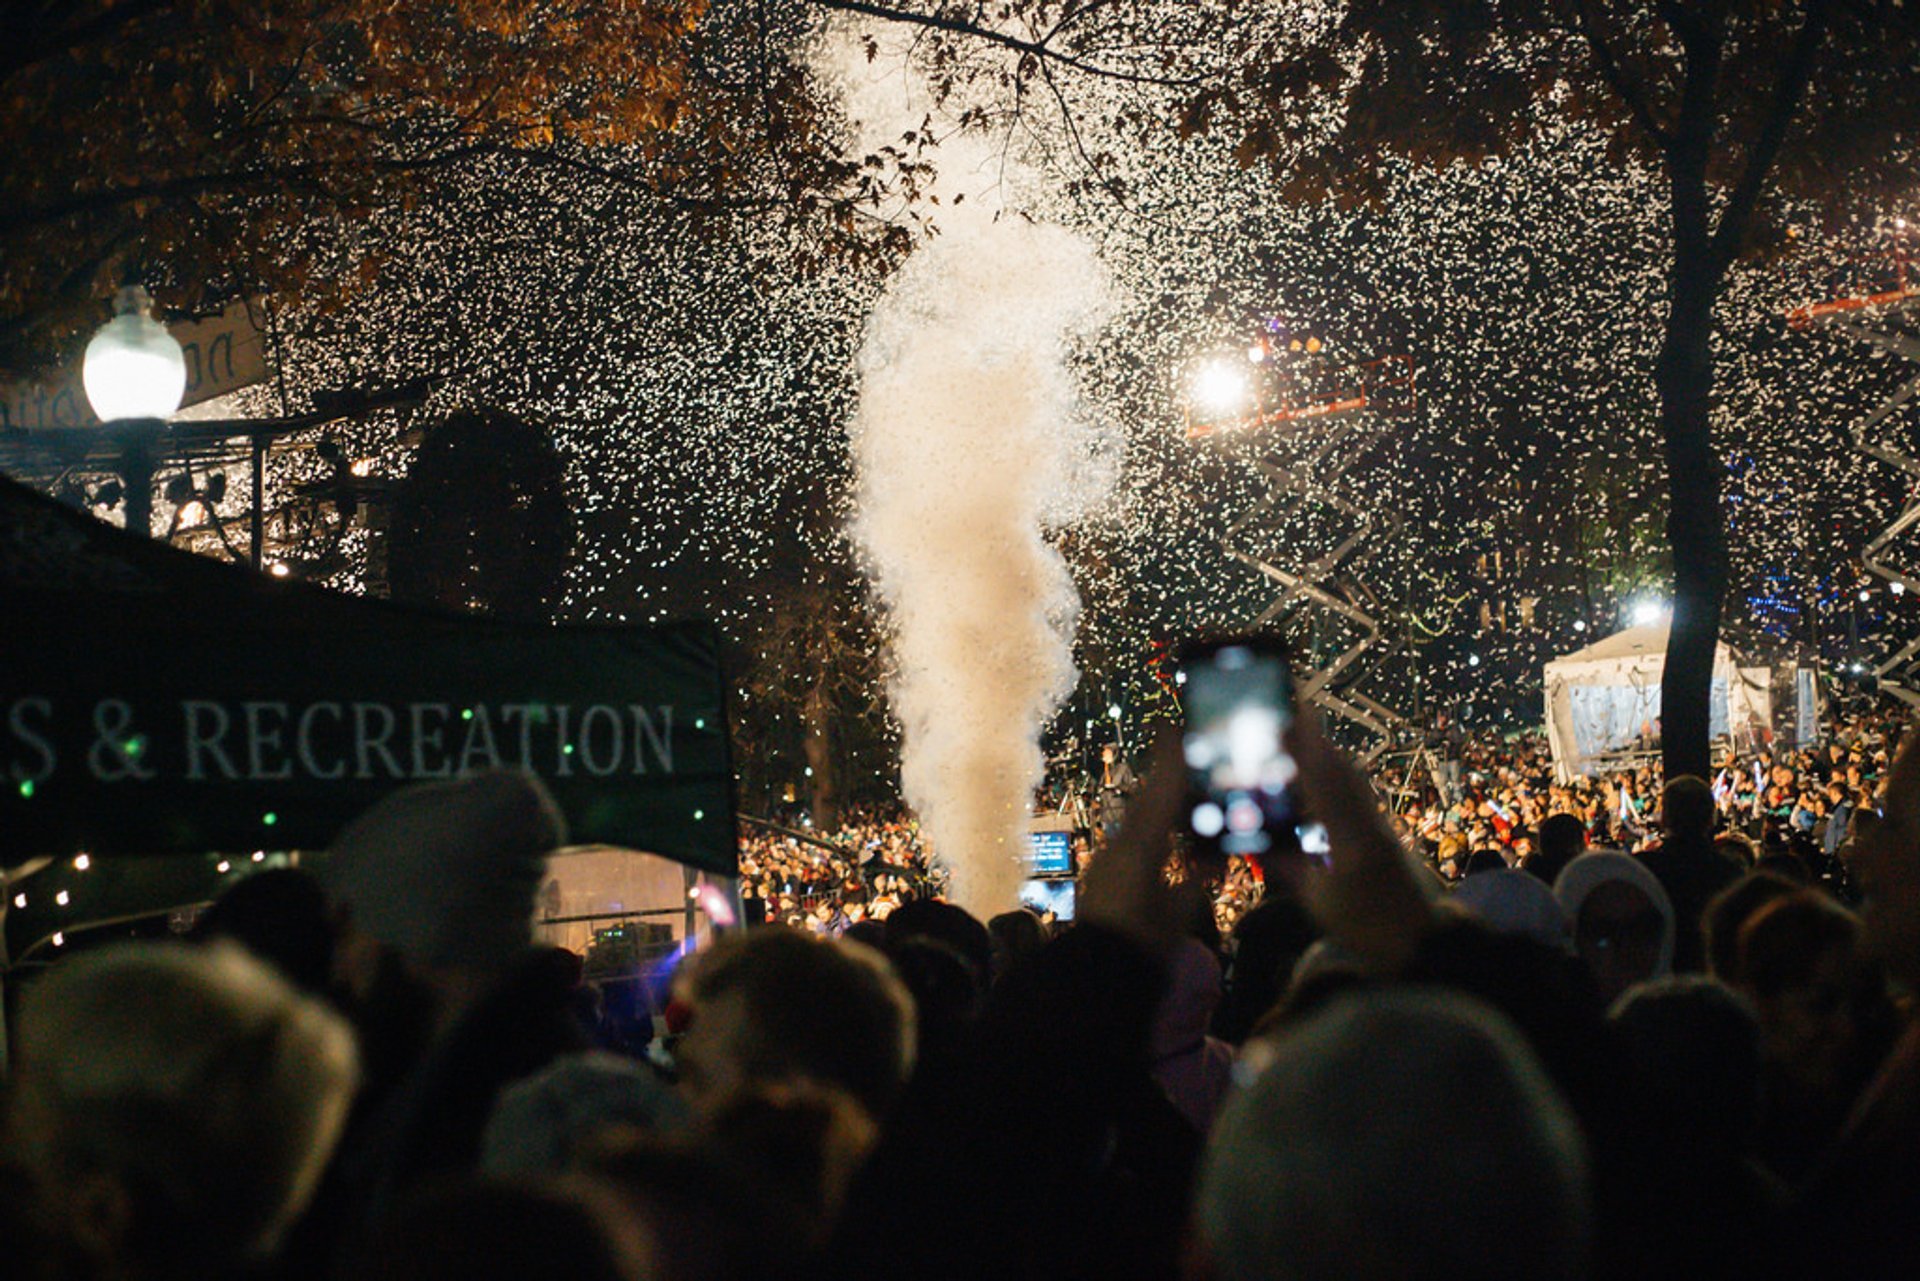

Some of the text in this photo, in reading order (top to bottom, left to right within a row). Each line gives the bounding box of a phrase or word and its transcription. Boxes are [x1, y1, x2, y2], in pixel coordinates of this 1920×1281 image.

[1, 697, 674, 783] S & RECREATION
